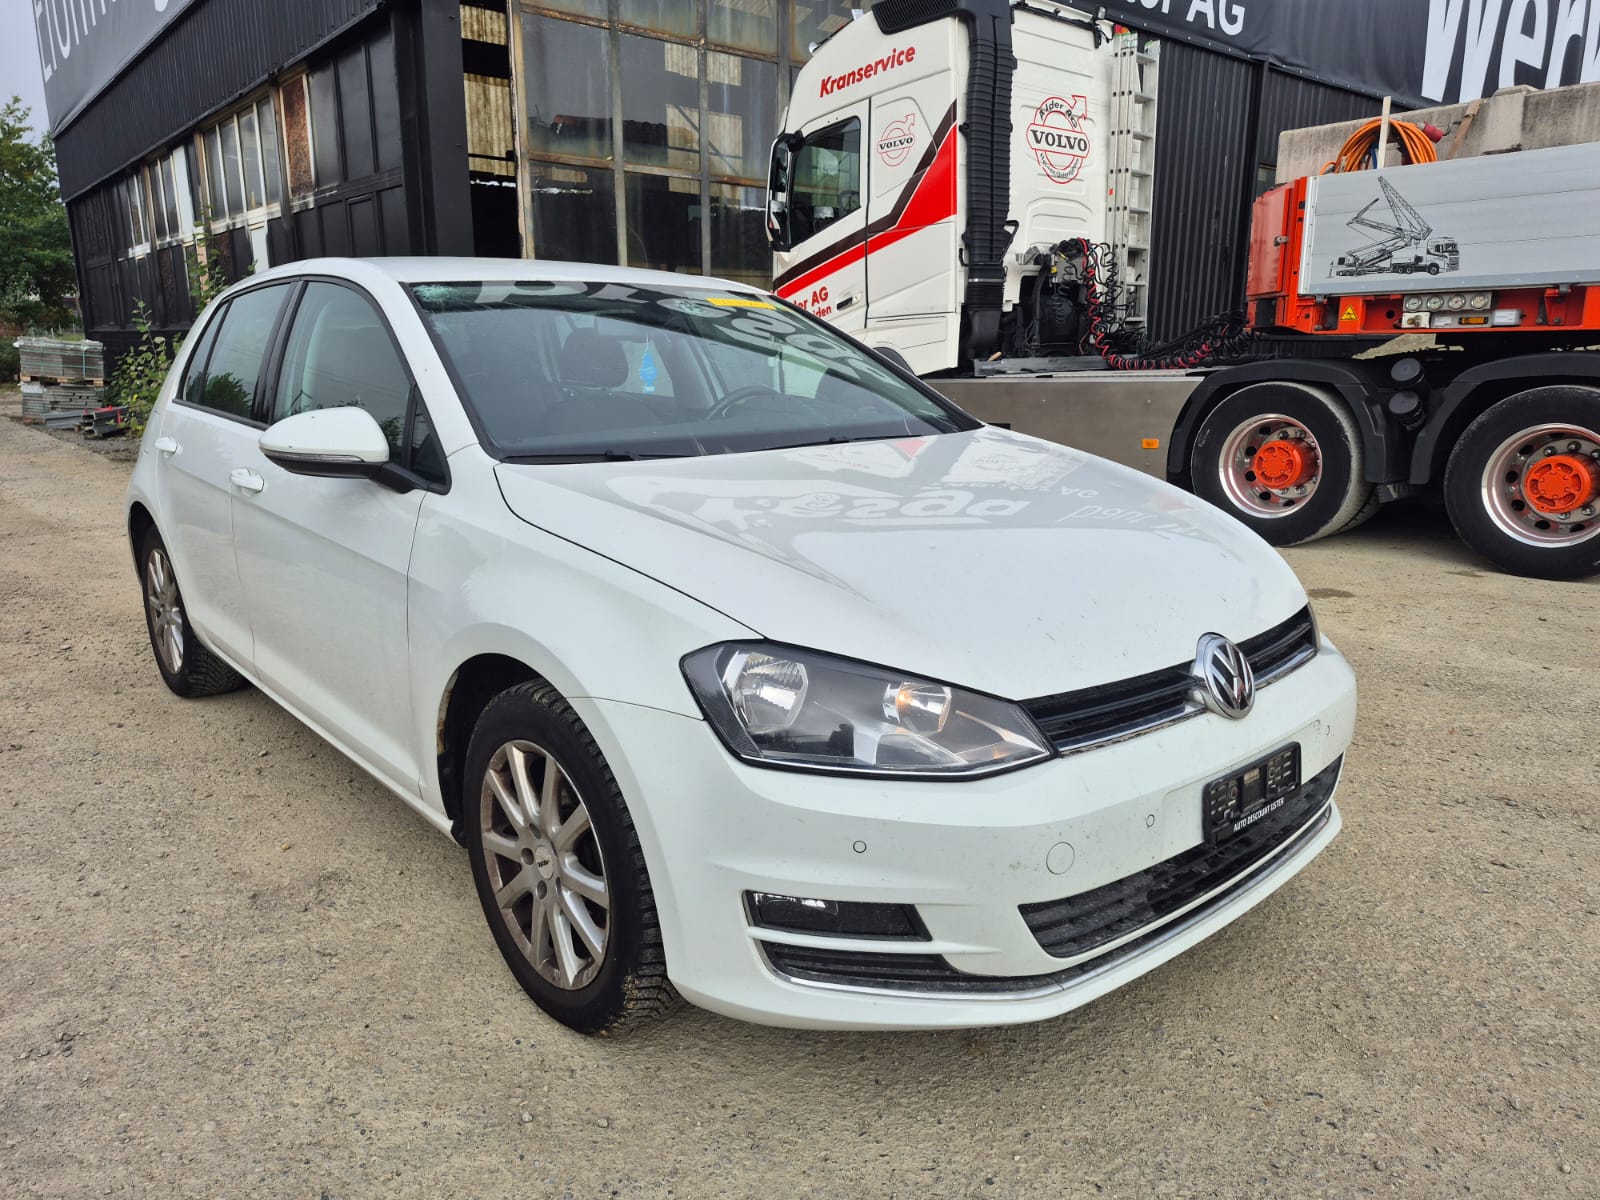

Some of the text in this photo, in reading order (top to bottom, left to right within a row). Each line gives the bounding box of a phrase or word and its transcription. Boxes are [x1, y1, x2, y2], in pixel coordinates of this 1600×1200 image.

[1186, 0, 1245, 36] AG
[820, 46, 916, 98] Kranservice
[880, 137, 914, 151] VOLVO
[1030, 129, 1088, 152] VOLVO
[811, 286, 829, 307] AG
[1204, 637, 1255, 718] VW
[1233, 818, 1247, 832] AUTO
[1247, 804, 1270, 825] DISCOUNT
